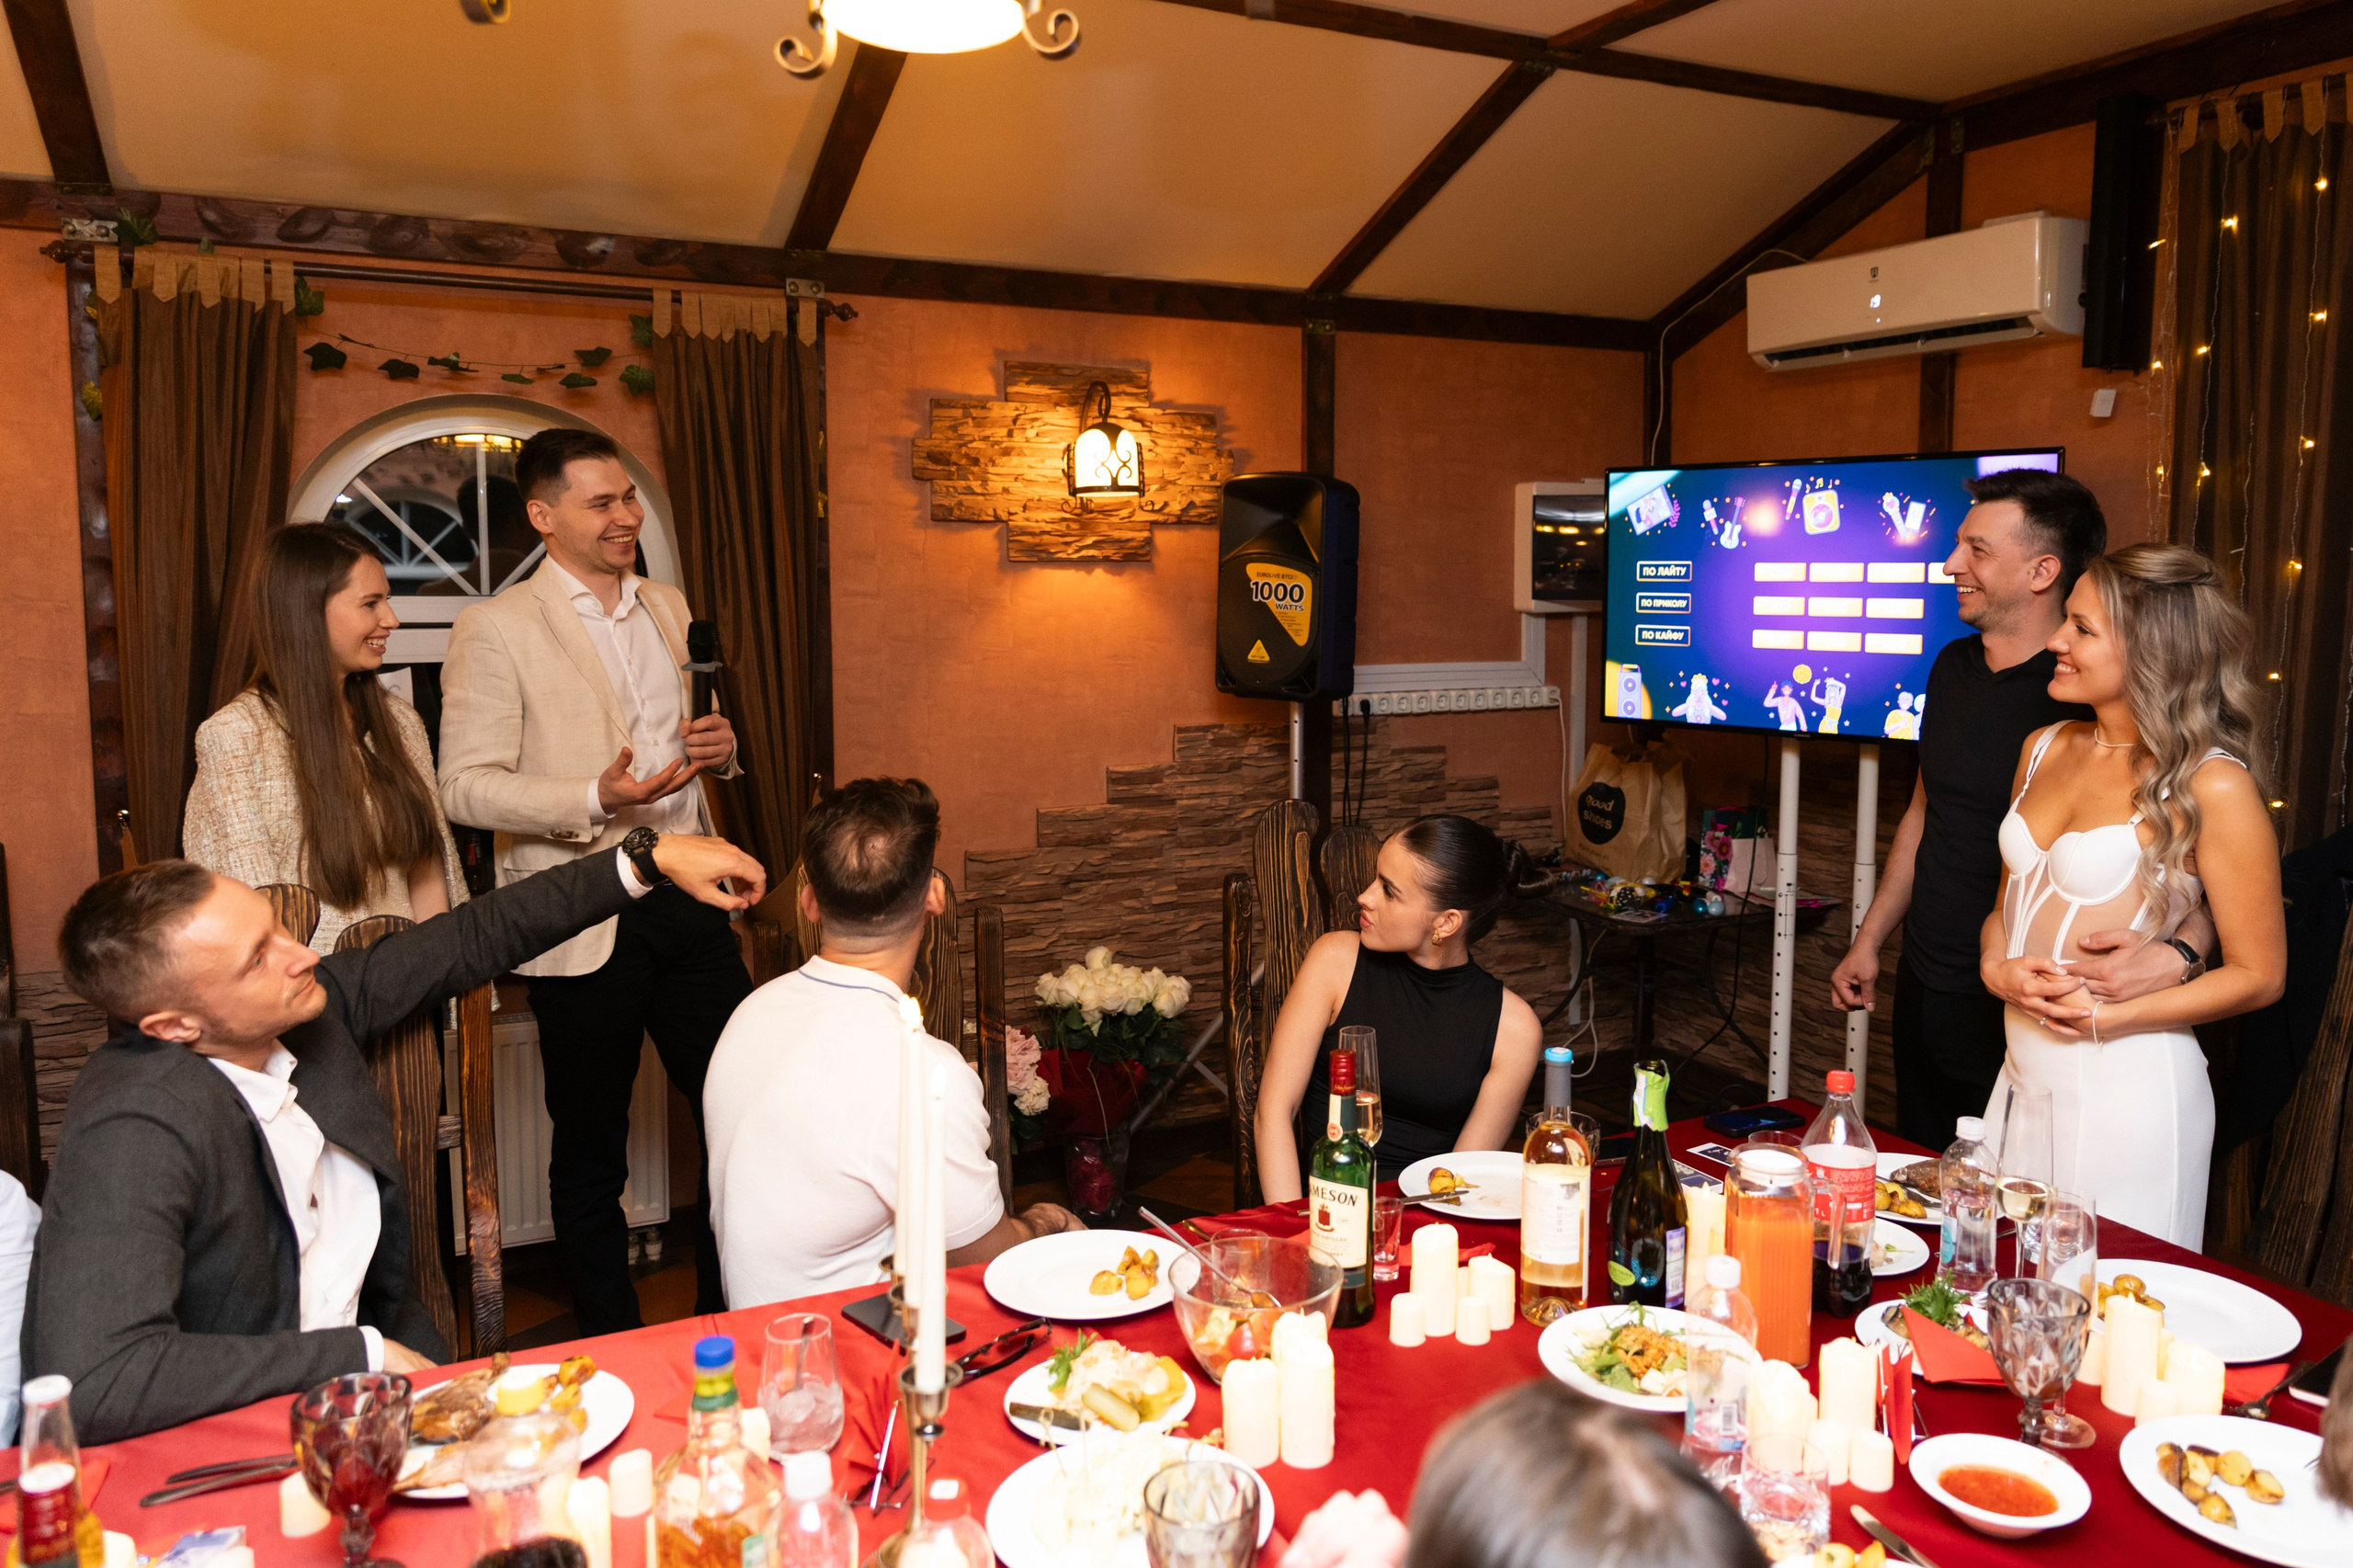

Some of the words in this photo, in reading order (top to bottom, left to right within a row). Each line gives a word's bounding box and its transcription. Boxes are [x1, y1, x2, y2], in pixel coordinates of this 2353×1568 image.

[1643, 566, 1656, 576] ПО
[1657, 565, 1687, 576] ЛАЙТУ
[1251, 580, 1305, 604] 1000
[1641, 598, 1653, 608] ПО
[1653, 599, 1688, 608] ПРИКОЛУ
[1642, 631, 1654, 640] ПО
[1654, 630, 1684, 641] КАЙФУ
[1586, 794, 1615, 812] good
[1583, 810, 1612, 830] shoes
